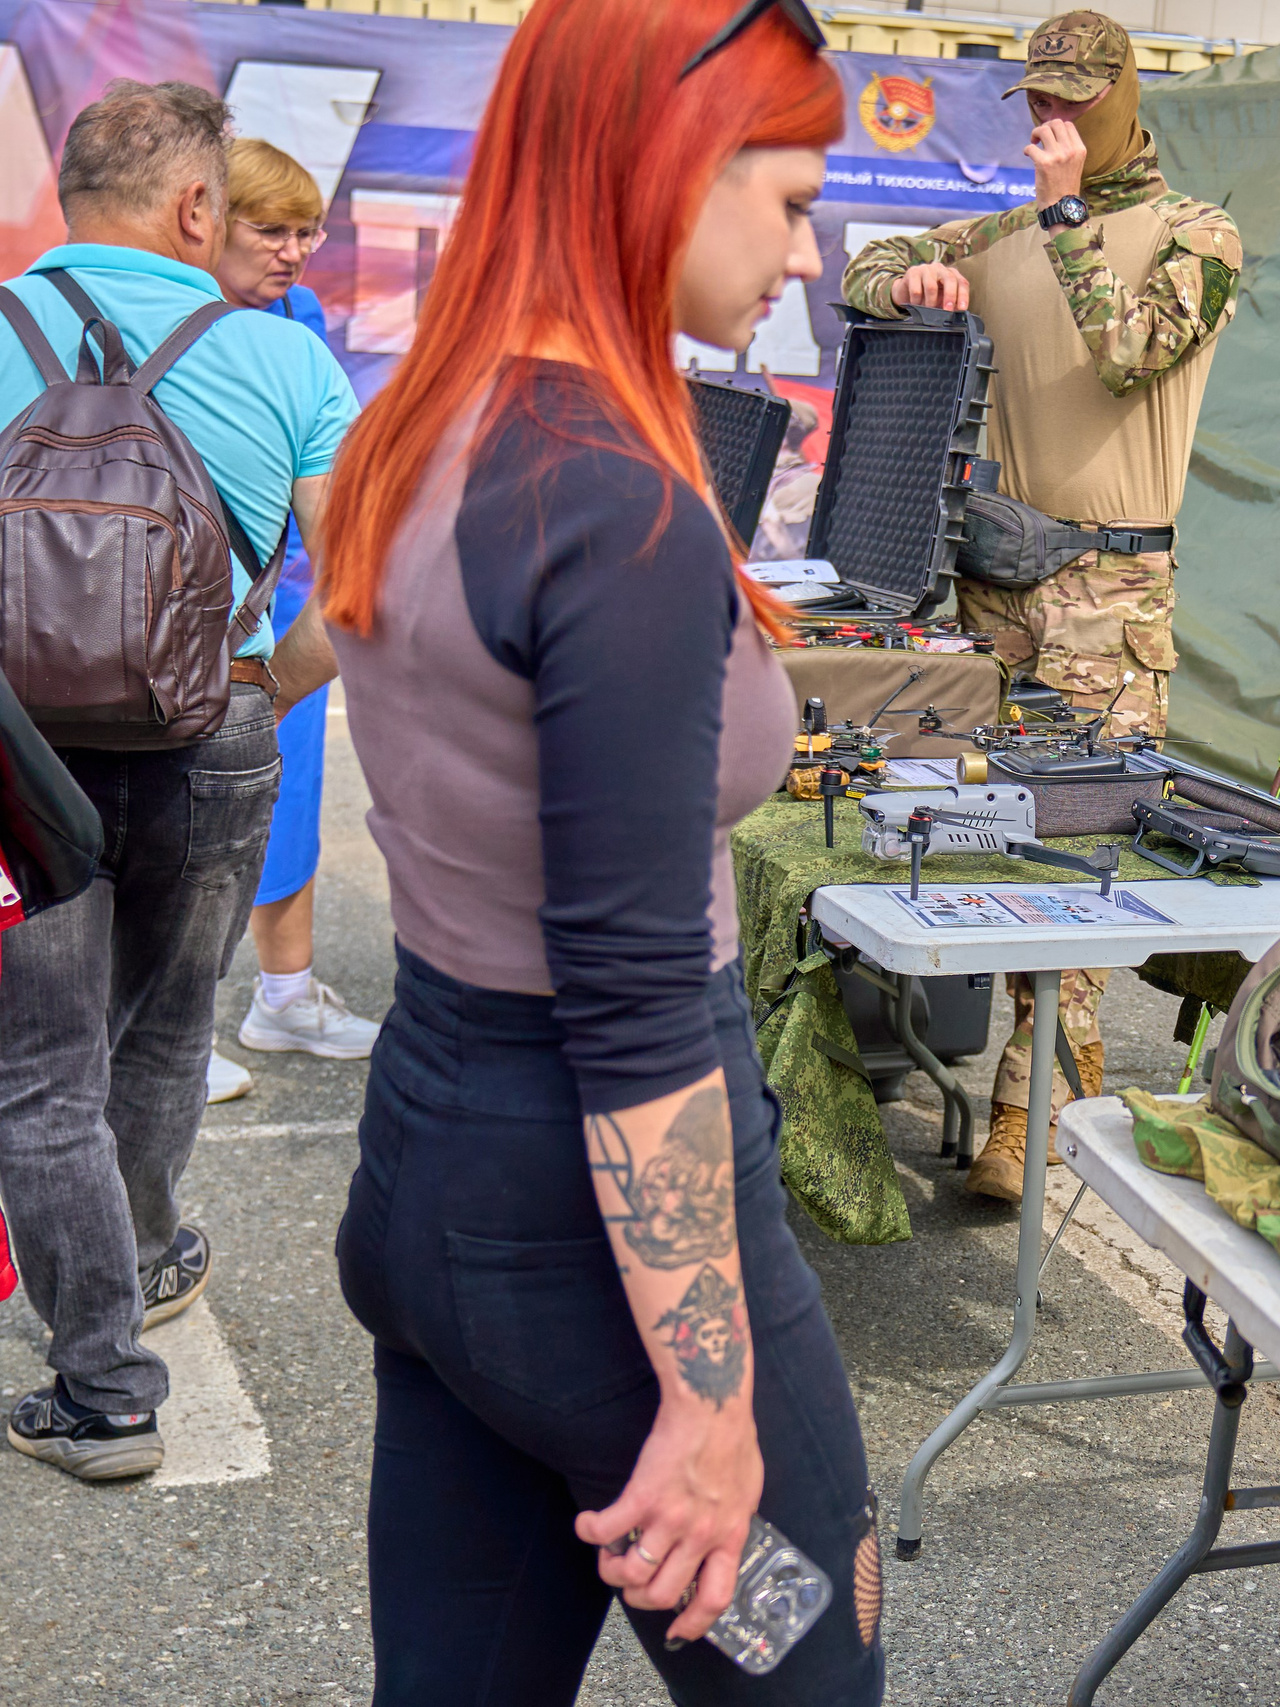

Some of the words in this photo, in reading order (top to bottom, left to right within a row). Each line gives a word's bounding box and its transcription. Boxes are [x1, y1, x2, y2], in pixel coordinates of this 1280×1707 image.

[875, 174, 1006, 195] ТИХООКЕАНСКИЙ
[1008, 185, 1037, 198] ФЛО
[158, 1265, 178, 1299] N
[34, 1401, 51, 1429] N
